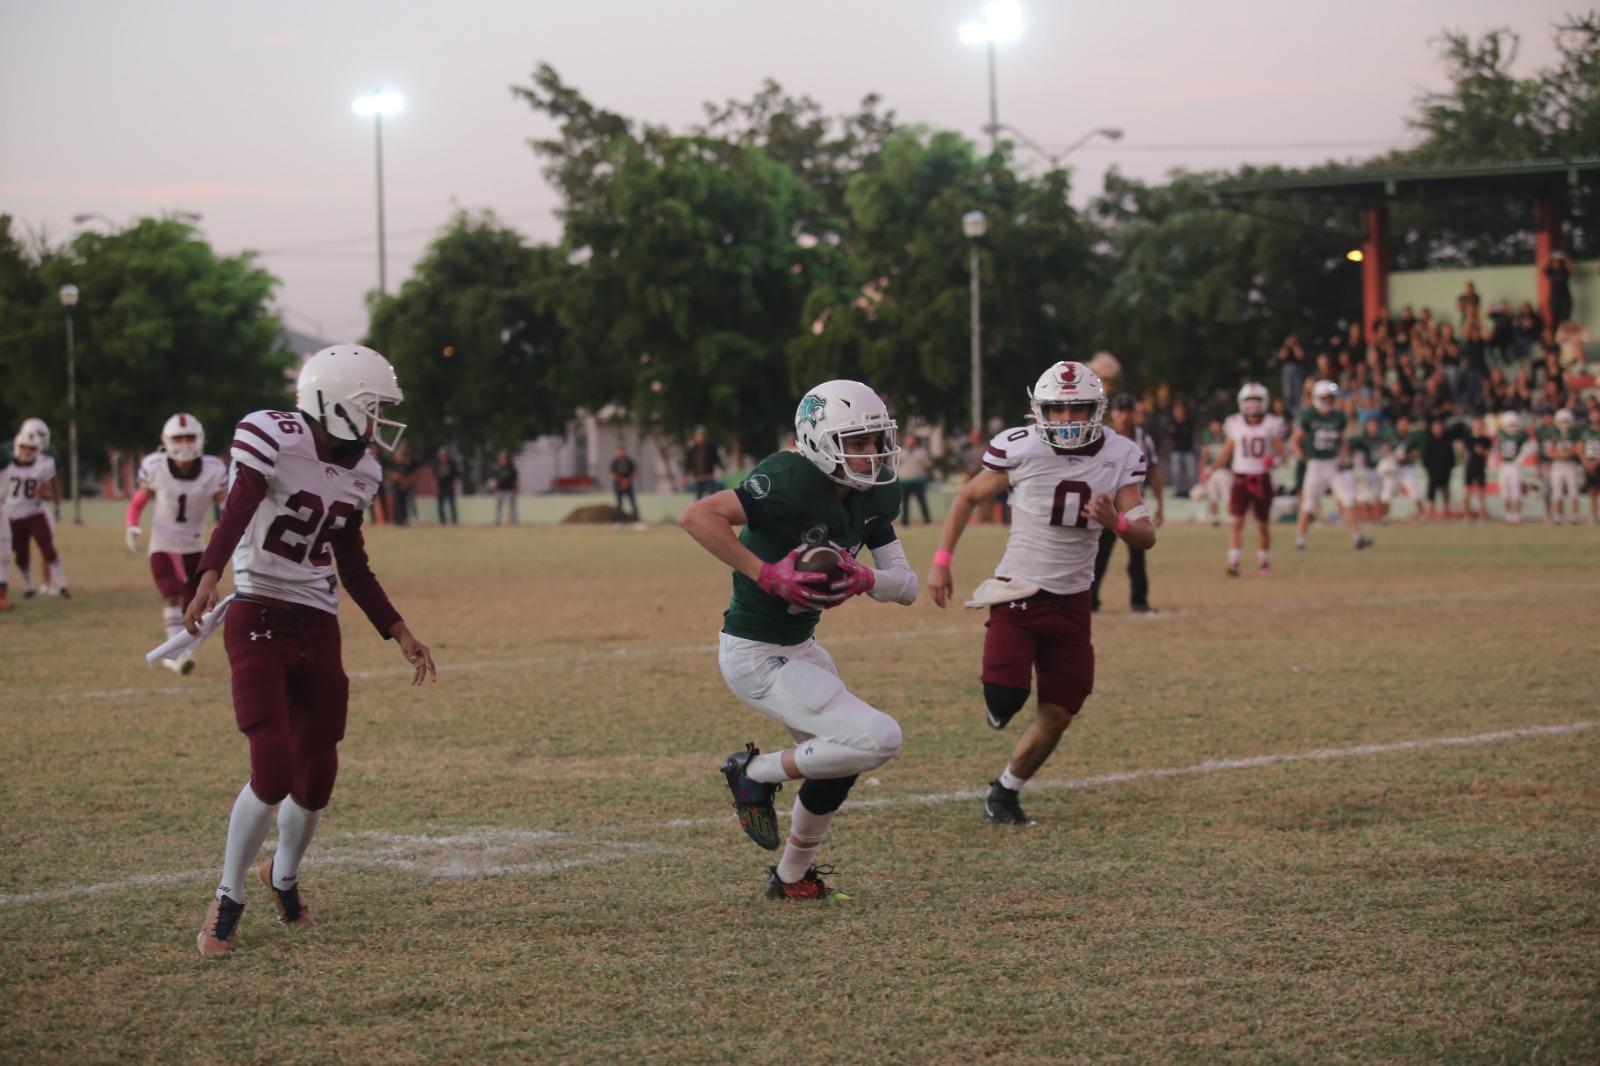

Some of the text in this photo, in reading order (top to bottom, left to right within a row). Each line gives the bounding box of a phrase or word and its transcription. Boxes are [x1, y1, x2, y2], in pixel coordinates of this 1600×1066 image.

[266, 411, 303, 435] 26
[1242, 437, 1265, 458] 10
[10, 477, 38, 498] 78
[175, 494, 188, 522] 1
